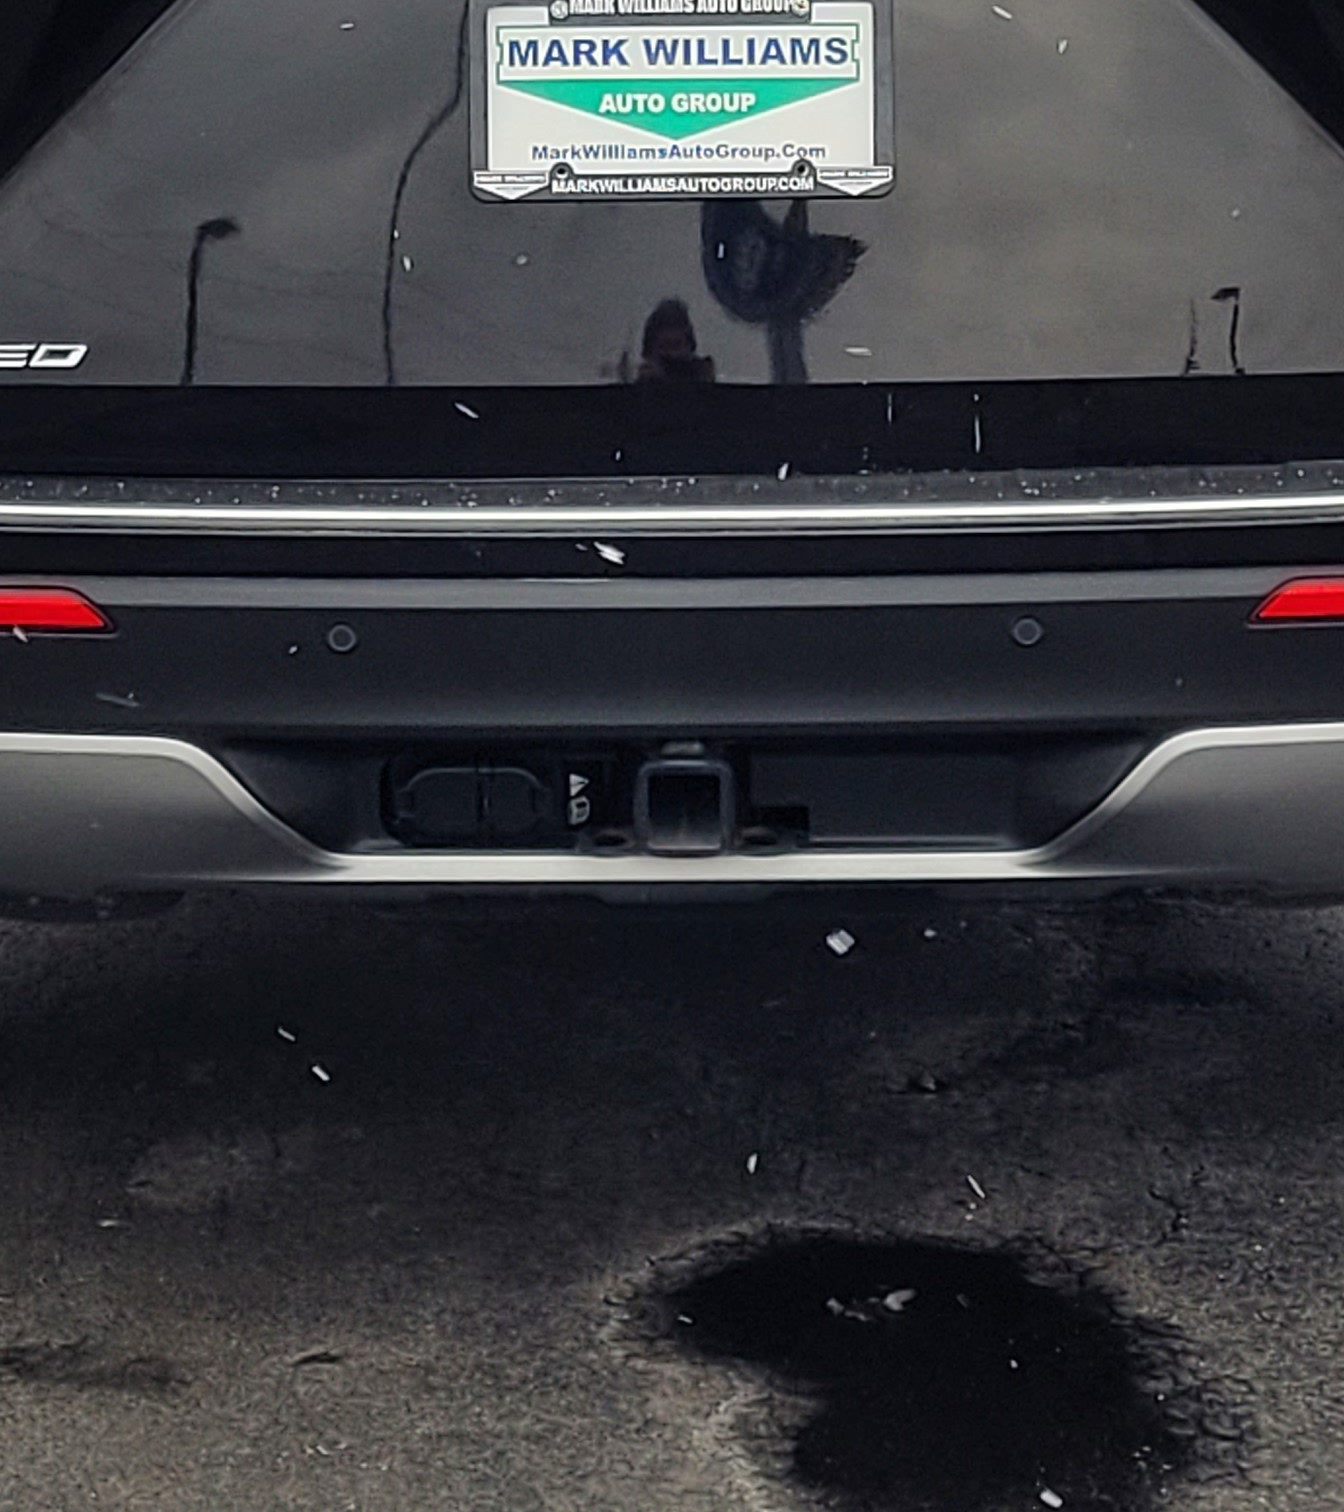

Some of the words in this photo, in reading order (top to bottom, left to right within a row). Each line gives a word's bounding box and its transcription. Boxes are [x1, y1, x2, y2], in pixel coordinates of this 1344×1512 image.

[508, 38, 630, 67] MARK
[643, 37, 849, 66] WILLIAMS
[599, 93, 666, 114] AUTO
[671, 92, 756, 113] GROUP
[531, 143, 826, 162] MarkWilliamsAutoGroup.Com
[551, 176, 814, 194] MARKWILLIAMSAUTOGROUP.COM
